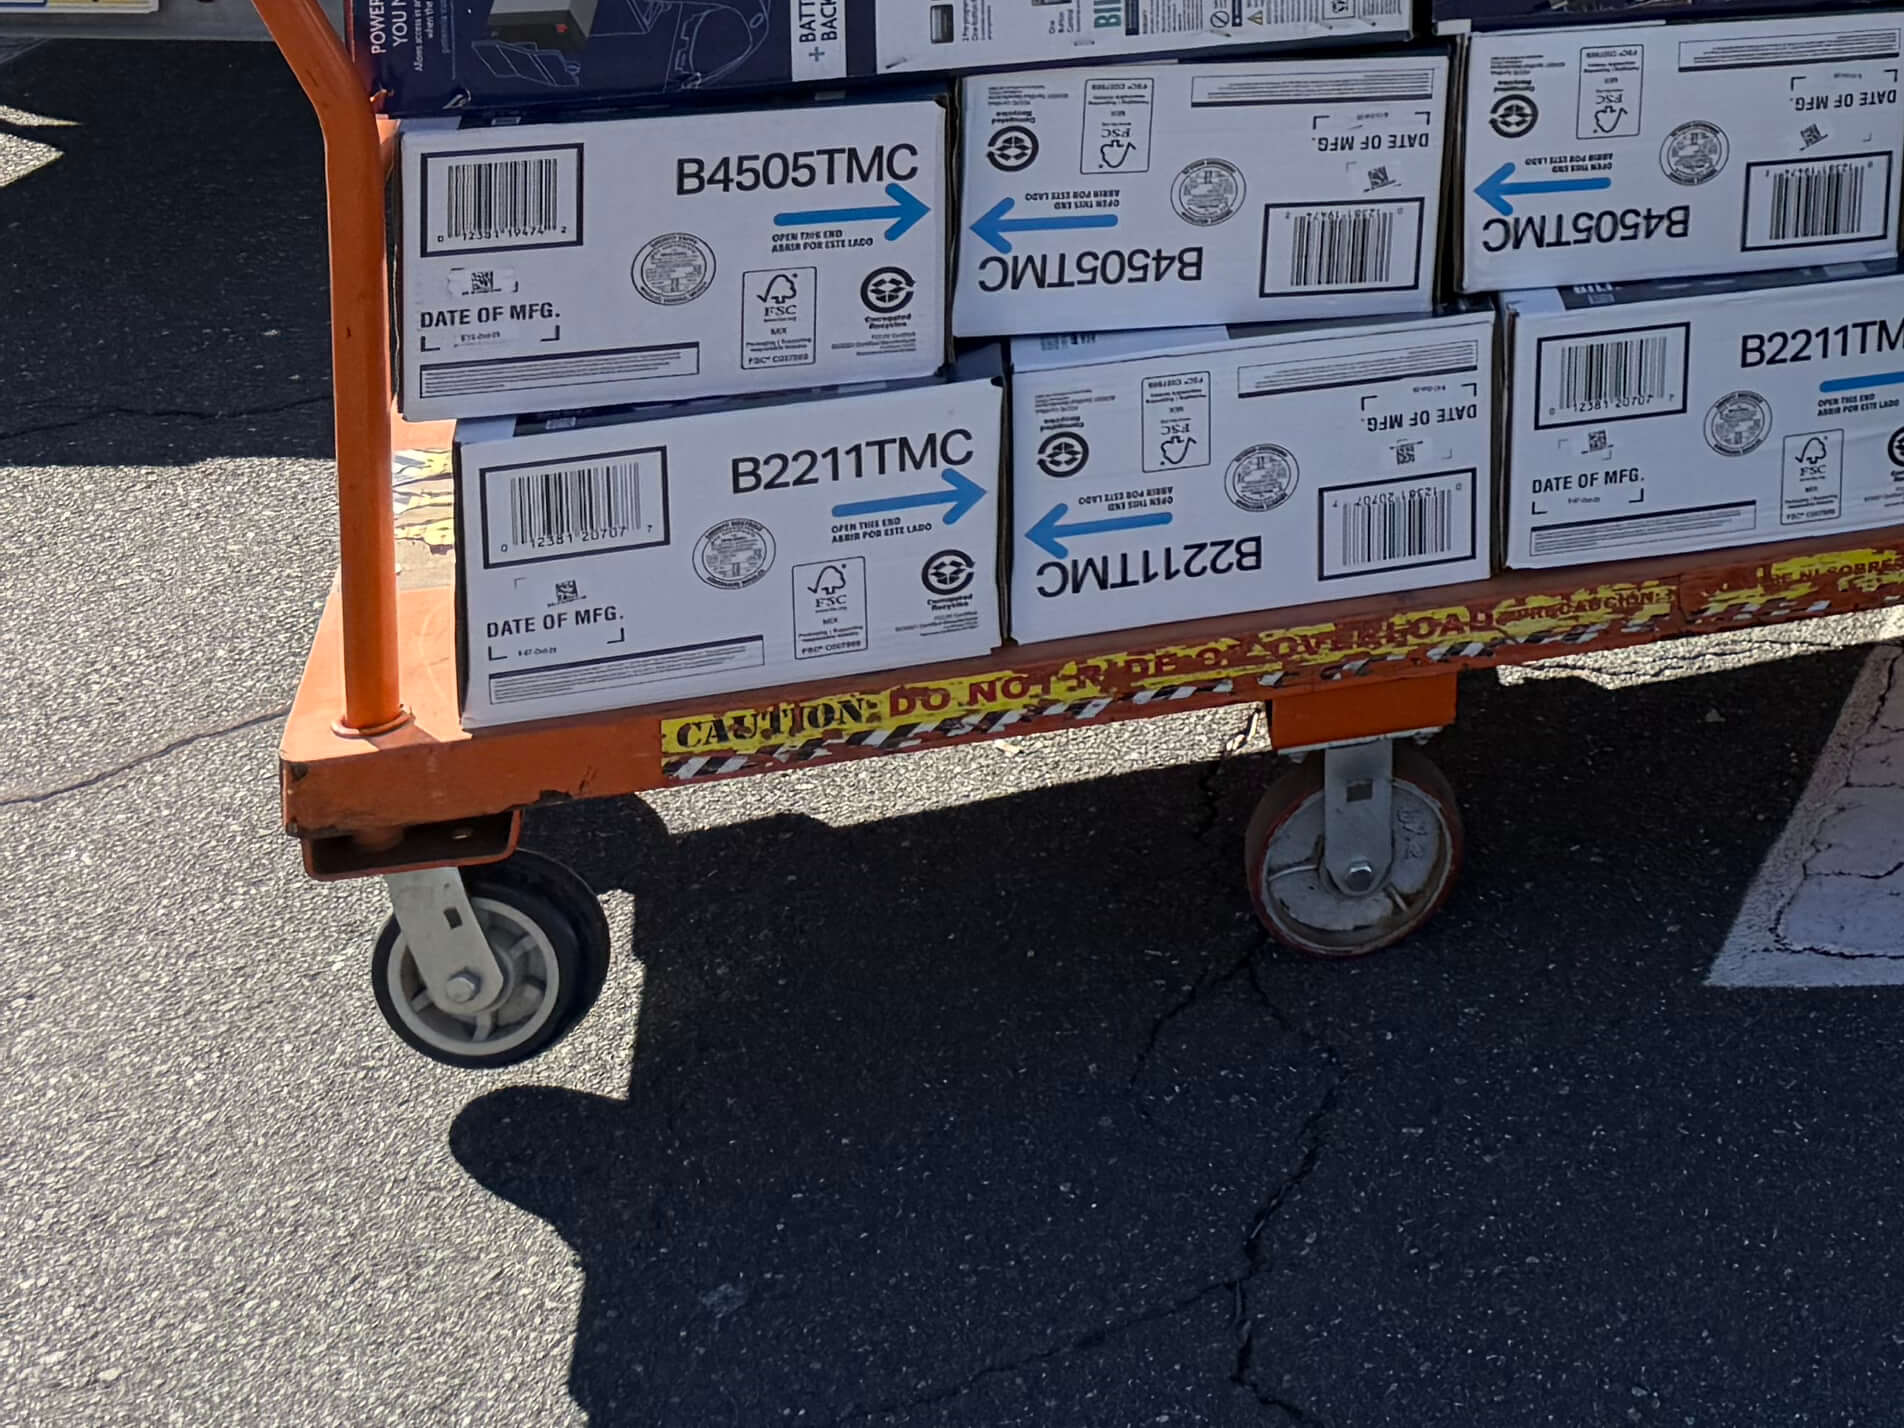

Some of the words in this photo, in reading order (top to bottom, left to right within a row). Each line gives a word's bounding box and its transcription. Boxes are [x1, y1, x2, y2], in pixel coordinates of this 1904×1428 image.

[392, 12, 409, 47] YOU
[1790, 95, 1829, 111] MFG.
[1833, 92, 1854, 107] OF
[1860, 89, 1896, 104] DATE
[1313, 135, 1355, 151] MFG.
[1360, 134, 1382, 149] OF
[1387, 133, 1429, 148] DATE
[676, 144, 919, 197] B4505TMC
[1482, 205, 1690, 253] B4505TMC
[977, 246, 1204, 293] B4505TMC
[420, 308, 472, 329] DATE
[477, 305, 504, 324] OF
[510, 302, 561, 321] MFG.
[763, 304, 798, 319] FSC
[1408, 409, 1431, 426] OF
[1436, 404, 1477, 422] DATE
[1361, 413, 1404, 432] MFG.
[730, 428, 975, 495] B2211TMC
[1532, 475, 1574, 494] DATE
[1579, 472, 1599, 488] OF
[1604, 466, 1645, 485] MFG.
[832, 521, 856, 533] OPEN
[1035, 534, 1263, 599] B2211TMC
[815, 593, 848, 609] FSC
[486, 618, 537, 639] DATE
[543, 613, 570, 631] OF
[575, 606, 624, 627] MFG.
[889, 683, 950, 716] DO
